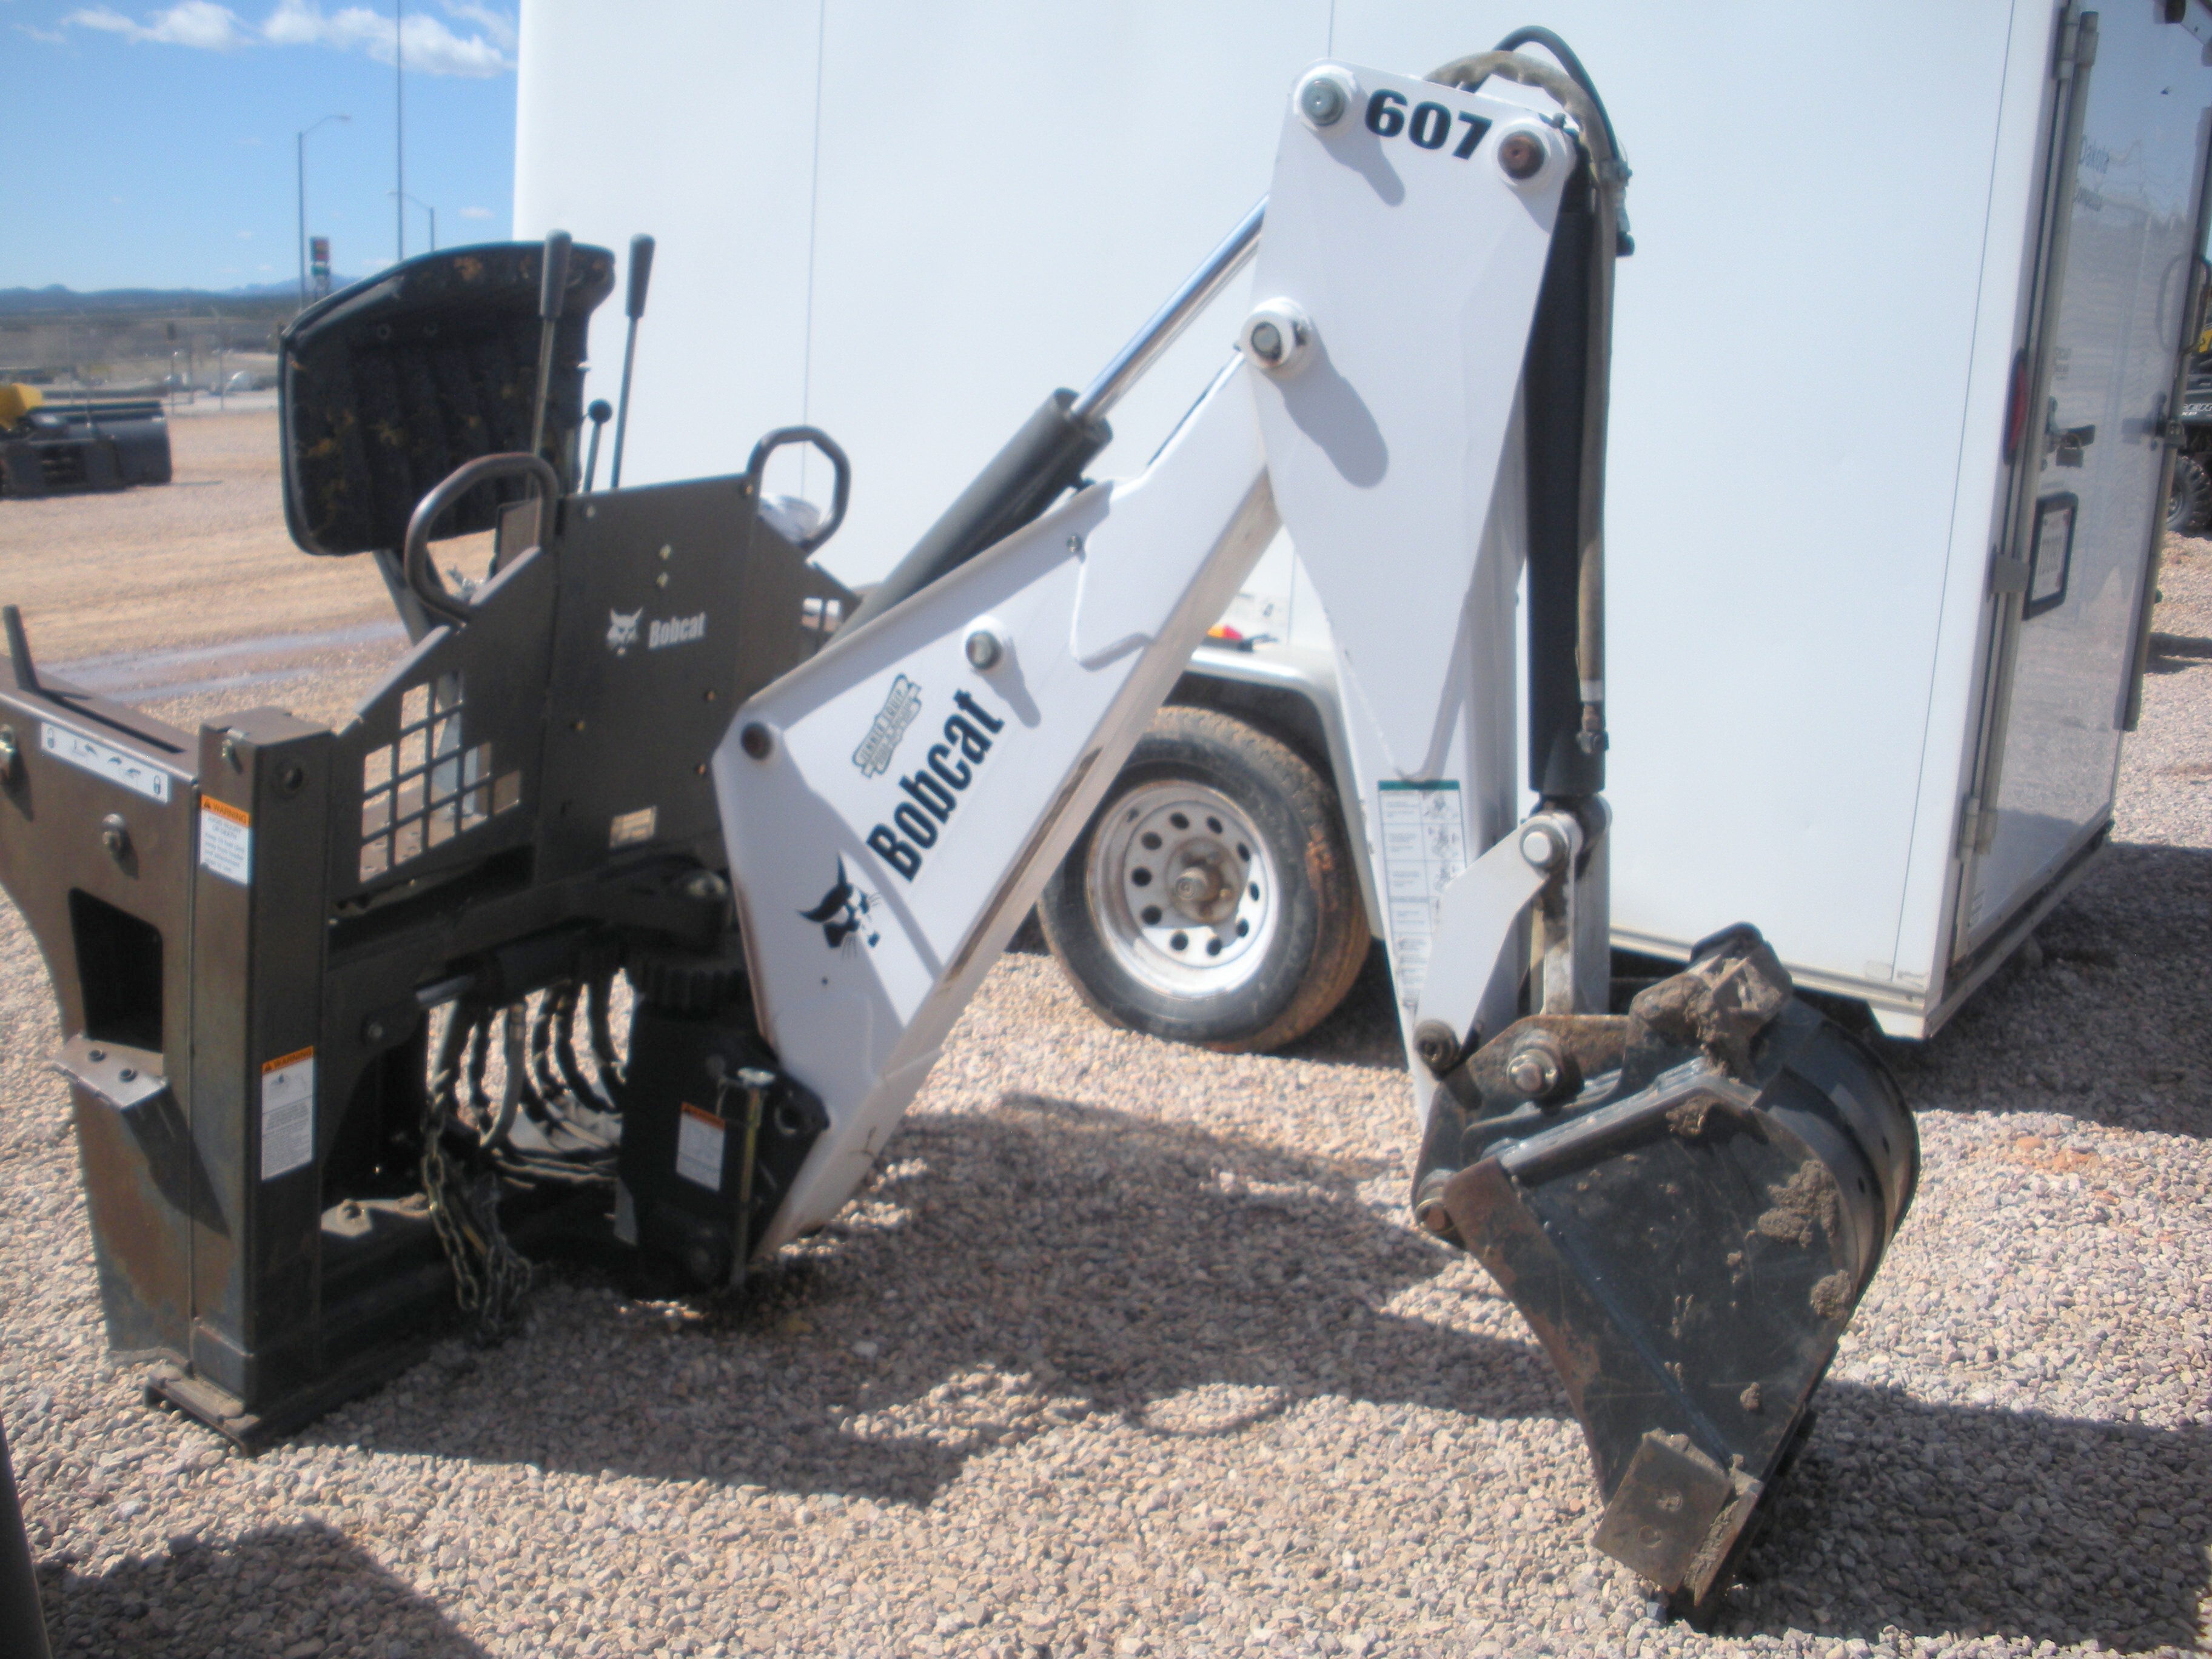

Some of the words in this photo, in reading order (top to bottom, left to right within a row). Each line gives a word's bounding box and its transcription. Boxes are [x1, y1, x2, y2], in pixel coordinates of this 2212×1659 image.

[1365, 89, 1493, 160] 607
[648, 611, 706, 650] Bobcat
[213, 803, 247, 823] WARNING
[866, 689, 1005, 882] Bobcat
